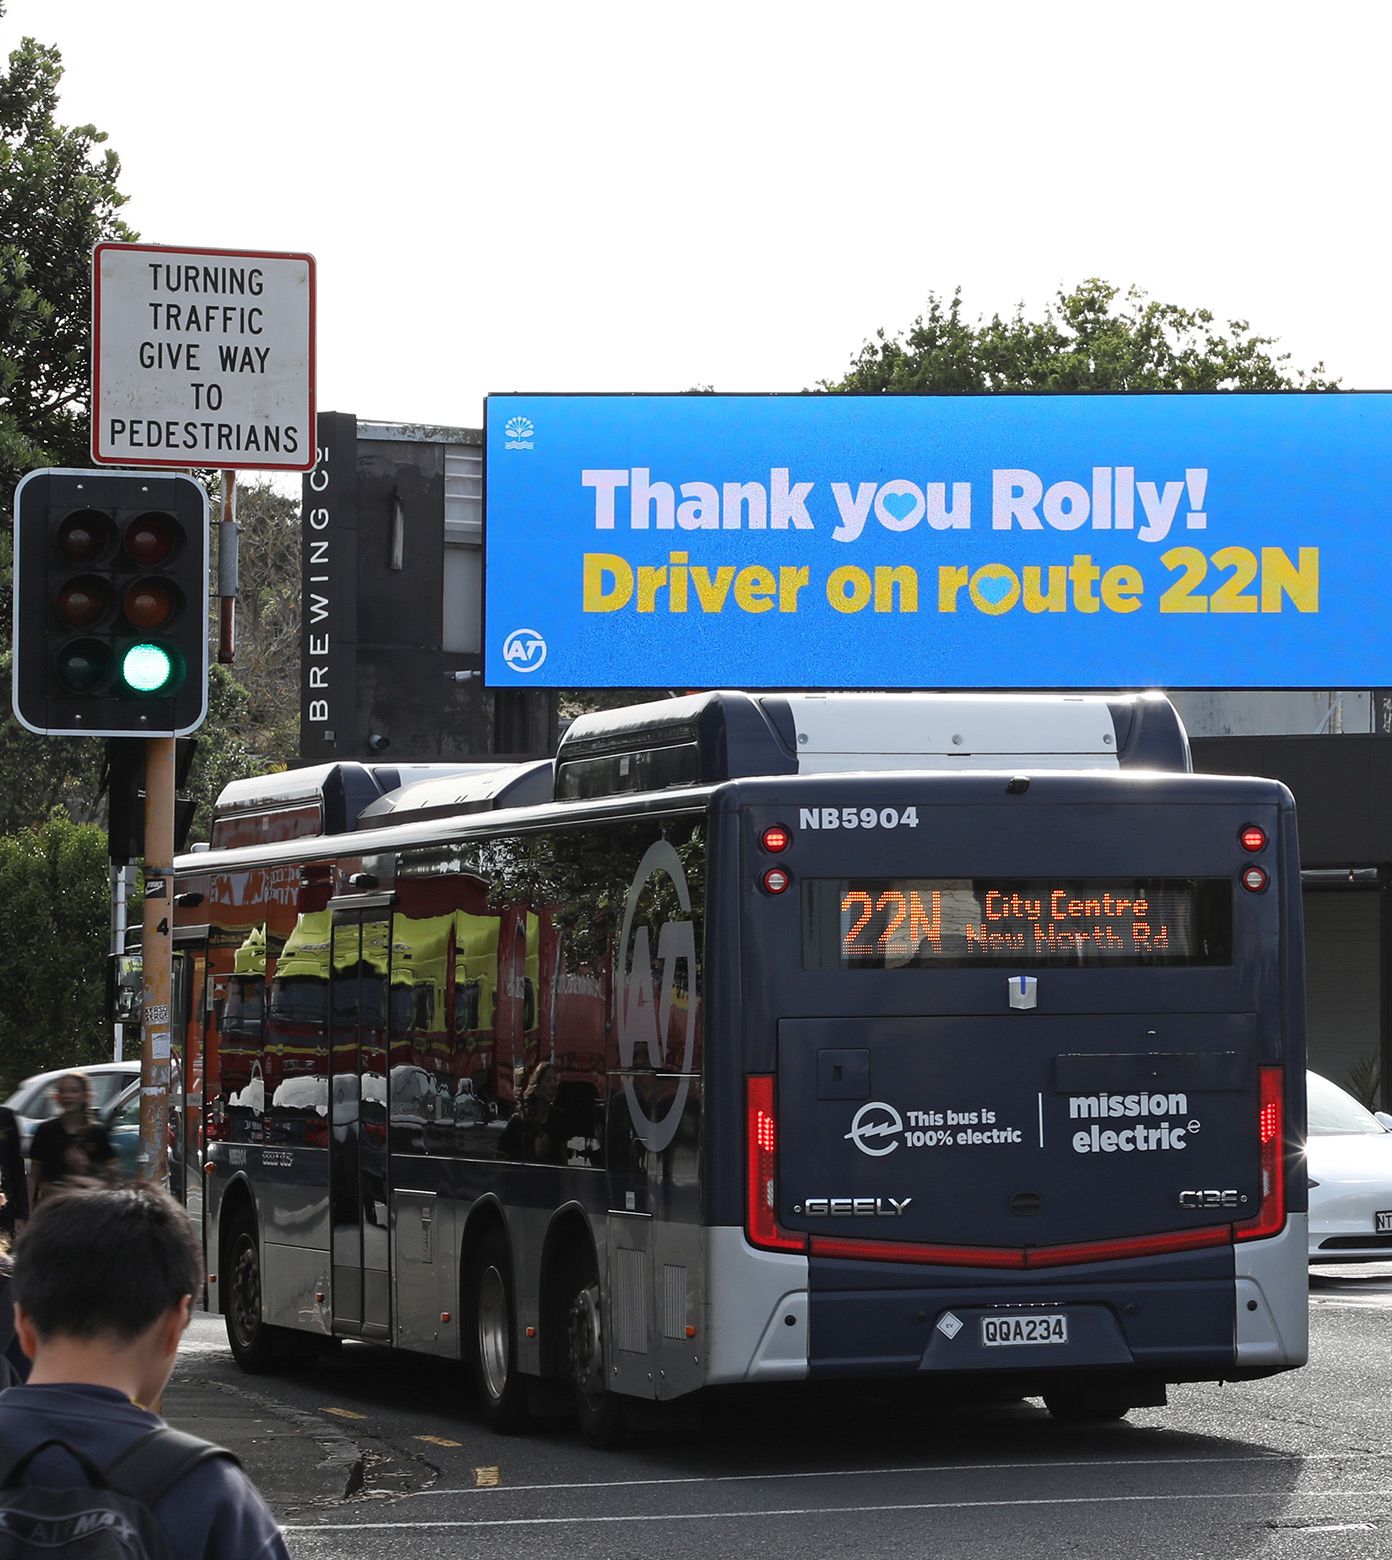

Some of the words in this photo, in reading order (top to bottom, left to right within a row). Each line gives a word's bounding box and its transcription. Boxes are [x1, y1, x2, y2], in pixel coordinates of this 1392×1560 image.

[149, 263, 264, 296] TURNING
[149, 302, 263, 335] TRAFFIC
[139, 341, 200, 371] GIVE
[218, 345, 271, 374] WAY
[190, 383, 223, 411] TO
[110, 418, 298, 453] PEDESTRIANS
[581, 467, 815, 530] Thank
[830, 478, 971, 543] you
[992, 466, 1208, 542] Rolly!
[582, 550, 809, 613] Driver
[825, 562, 918, 613] on
[938, 554, 1144, 617] route
[1159, 545, 1320, 613] 22N
[309, 508, 329, 722] BREWING
[799, 805, 919, 830] NB5904
[156, 917, 169, 936] 4
[840, 890, 942, 955] 22N
[984, 889, 1041, 922] City
[1050, 889, 1149, 920] Centre
[1035, 922, 1124, 953] North
[1134, 922, 1170, 953] Rd
[906, 1110, 944, 1127] This
[946, 1109, 979, 1126] bus
[981, 1108, 996, 1124] is
[1069, 1091, 1188, 1119] mission
[904, 1129, 954, 1147] 100%
[956, 1127, 1022, 1145] electric
[803, 1197, 913, 1217] GEELY
[1179, 1189, 1238, 1208] C13E
[985, 1318, 1065, 1342] QQA234
[73, 1512, 138, 1541] MAX
